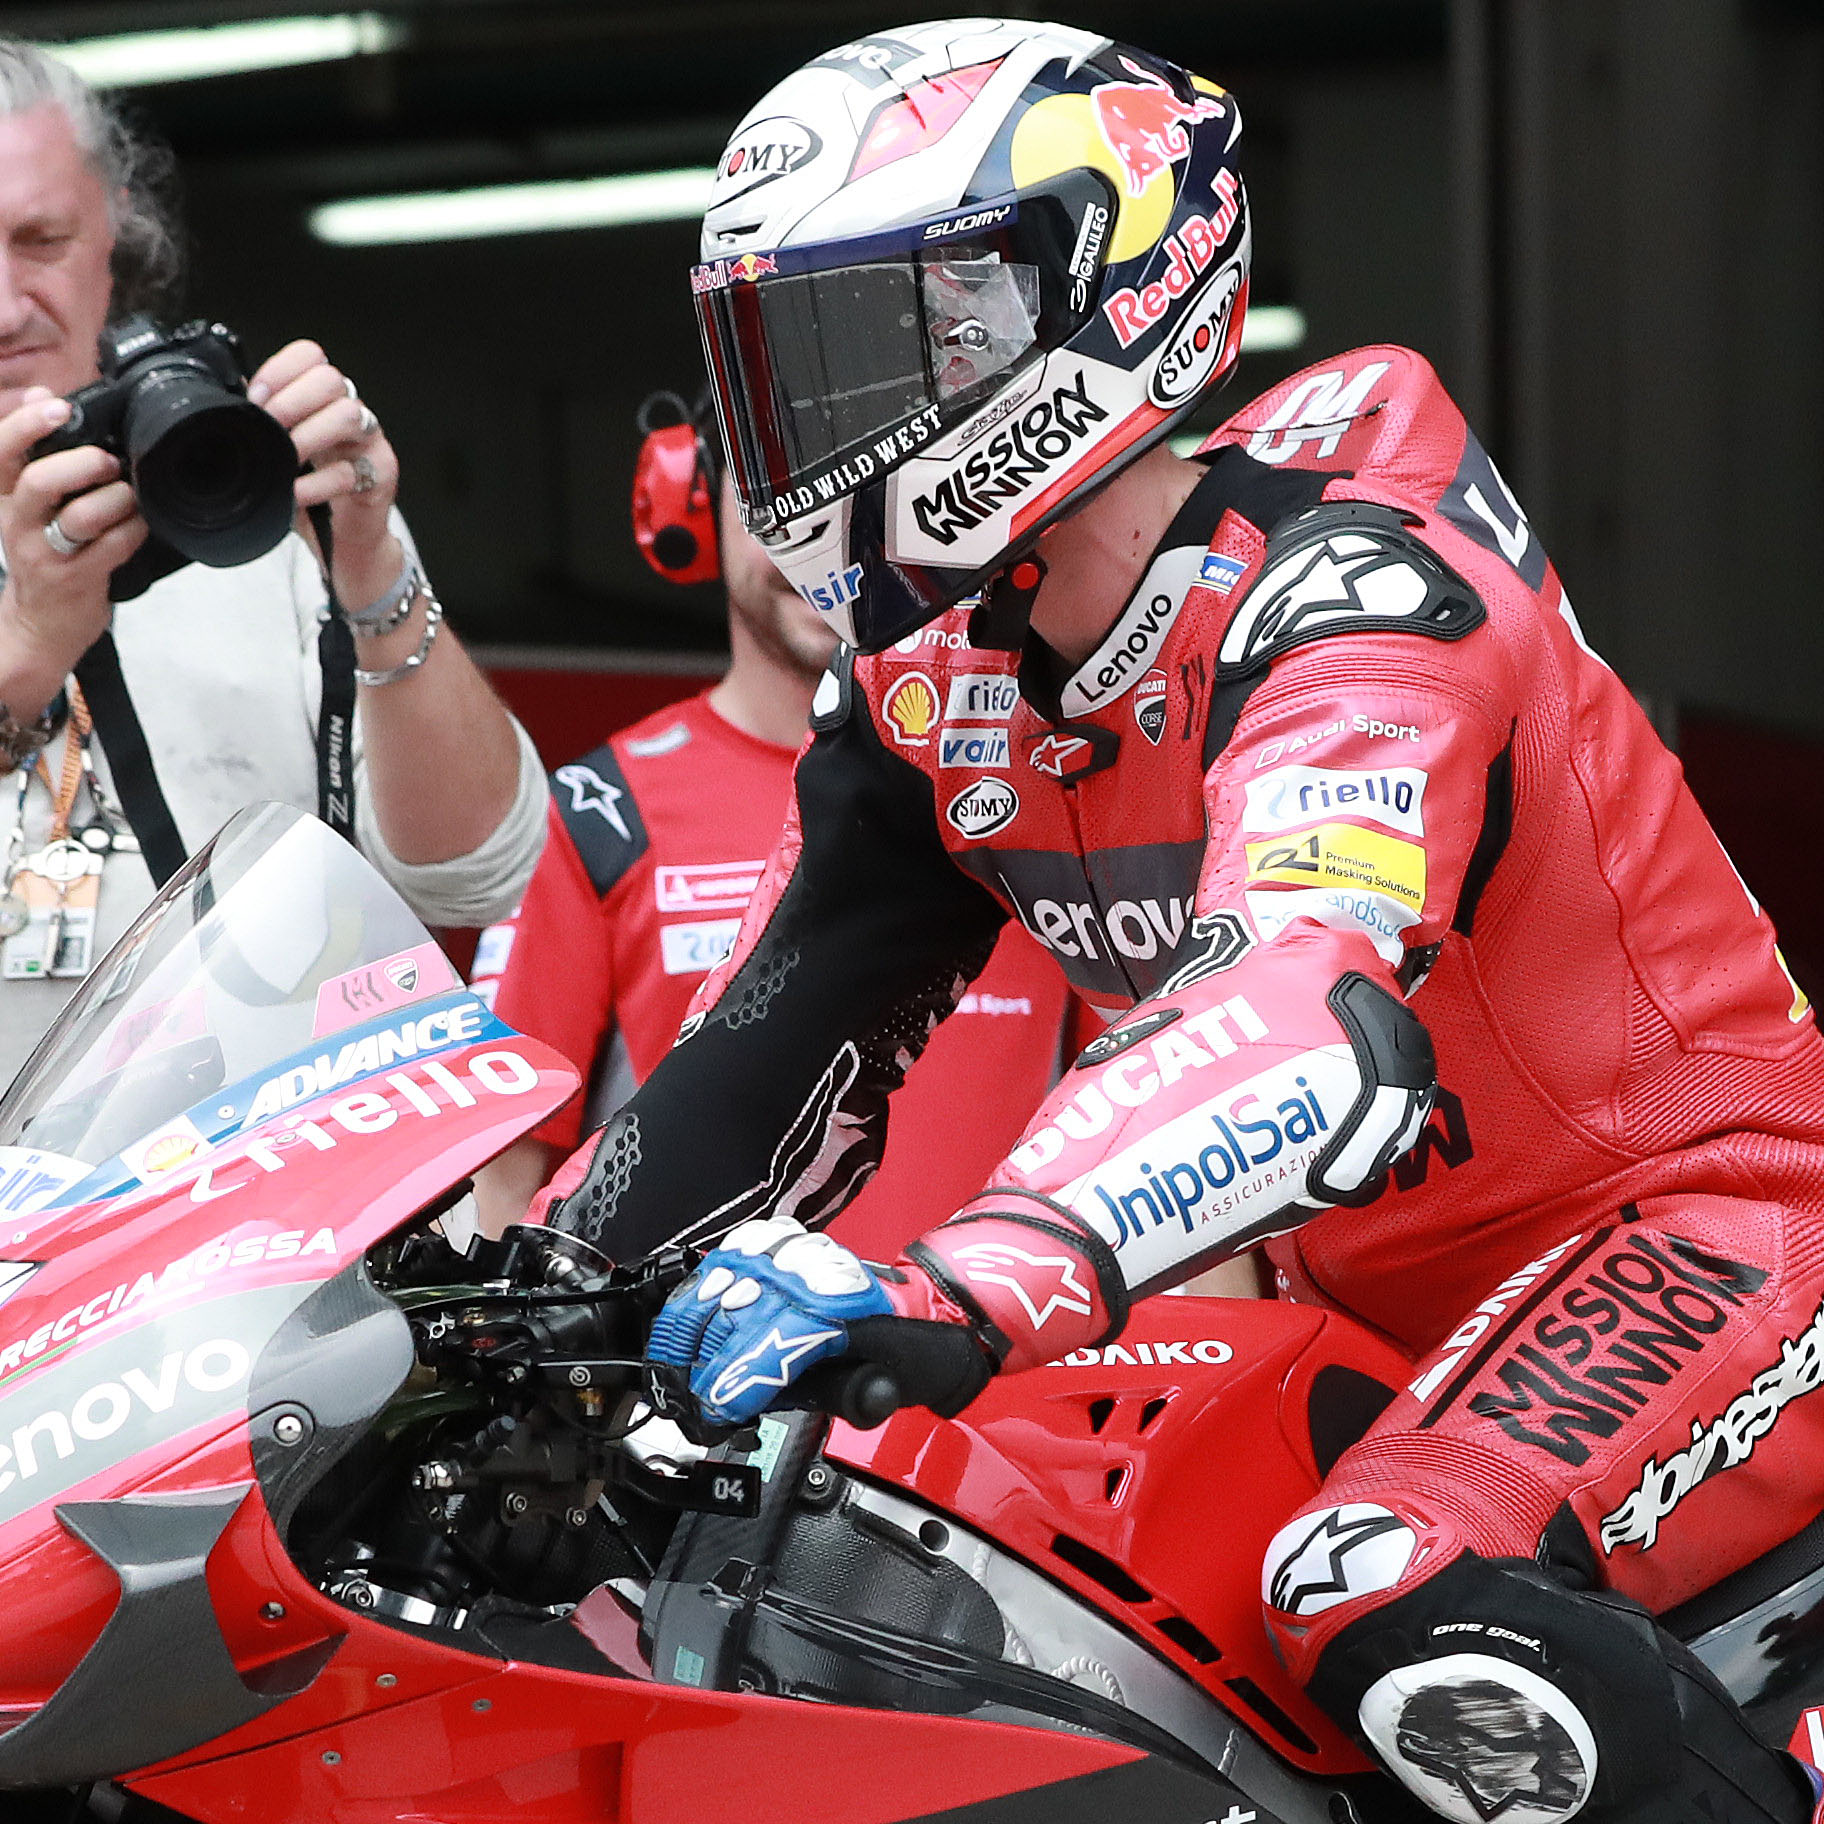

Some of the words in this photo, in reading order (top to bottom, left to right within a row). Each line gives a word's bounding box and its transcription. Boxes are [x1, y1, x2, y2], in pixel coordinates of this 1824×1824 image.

[716, 143, 804, 184] UOMY
[923, 205, 1010, 240] SUOMY
[1159, 279, 1239, 386] SUOMY
[777, 487, 815, 519] OLD
[815, 452, 876, 499] WILD
[873, 403, 943, 466] WEST
[913, 369, 1088, 516] MISSION
[920, 400, 1110, 546] WINNOW
[800, 561, 863, 613] lsir
[1075, 594, 1173, 703] Lenovo
[328, 713, 345, 789] Nikon
[1289, 719, 1347, 754] Audi
[1352, 714, 1421, 743] Sport
[1299, 776, 1413, 815] riello
[1325, 850, 1376, 871] Premium
[1325, 865, 1373, 886] Masking
[1374, 875, 1421, 900] Solutions
[997, 871, 1195, 967] Lenov
[238, 999, 482, 1128] ADVANCE
[1008, 996, 1269, 1175] DUCATI
[244, 1050, 539, 1174] riello
[1468, 1232, 1766, 1430] MISSION
[714, 1476, 745, 1503] 04
[1432, 1622, 1484, 1637] one
